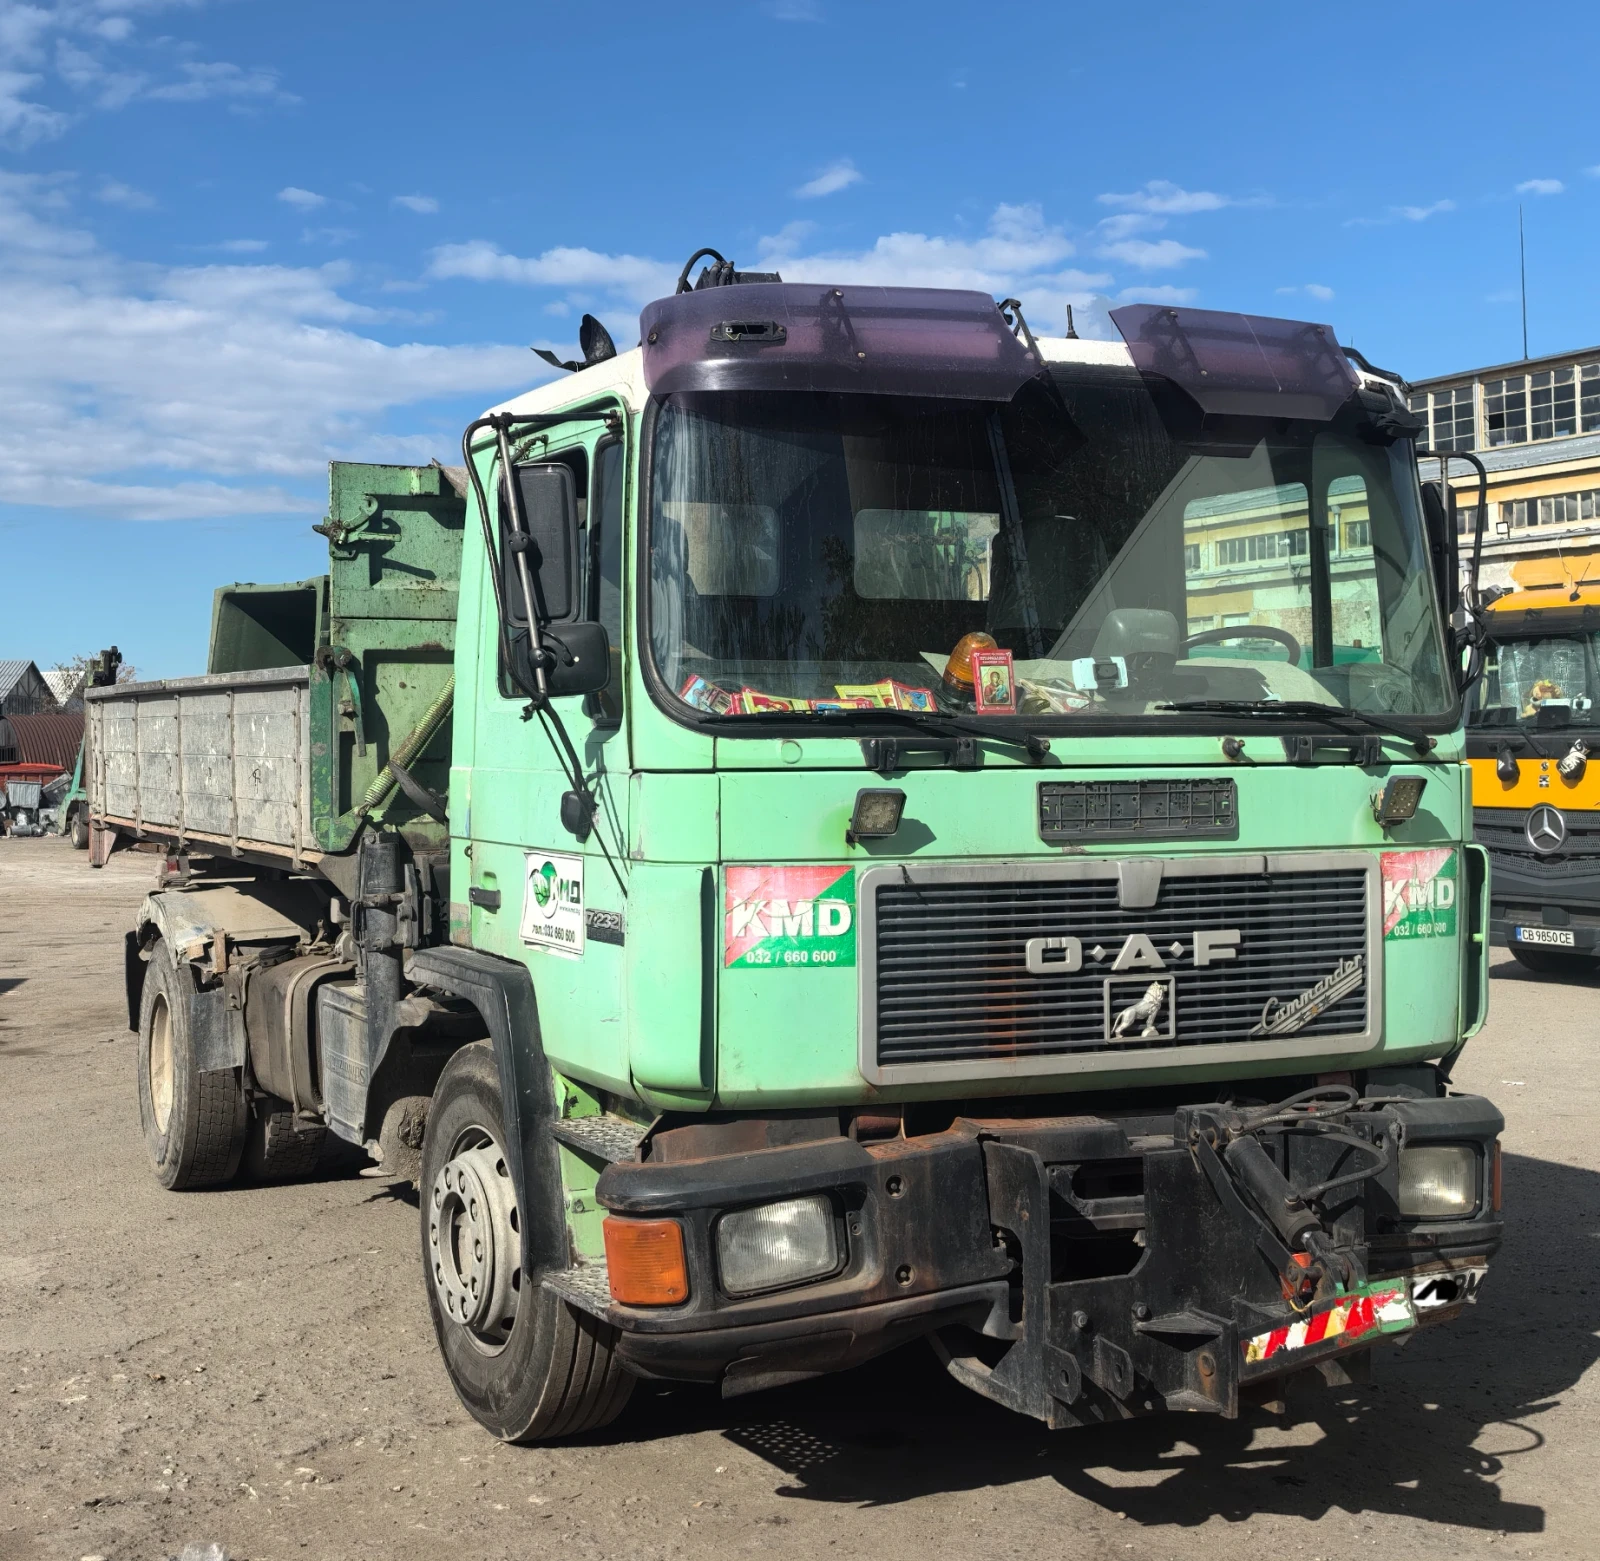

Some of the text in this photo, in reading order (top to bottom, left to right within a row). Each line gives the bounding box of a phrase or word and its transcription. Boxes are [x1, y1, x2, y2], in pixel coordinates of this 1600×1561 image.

[1384, 878, 1455, 913] KMD
[732, 897, 852, 937] KMD
[554, 926, 564, 940] 660
[565, 929, 575, 943] 600
[1394, 923, 1410, 936] 032
[1417, 924, 1432, 934] 660
[1522, 929, 1573, 945] CB 9850 CE
[746, 951, 771, 964] 032
[783, 950, 808, 963] 660
[812, 950, 837, 962] 600
[1261, 954, 1363, 1031] Commander
